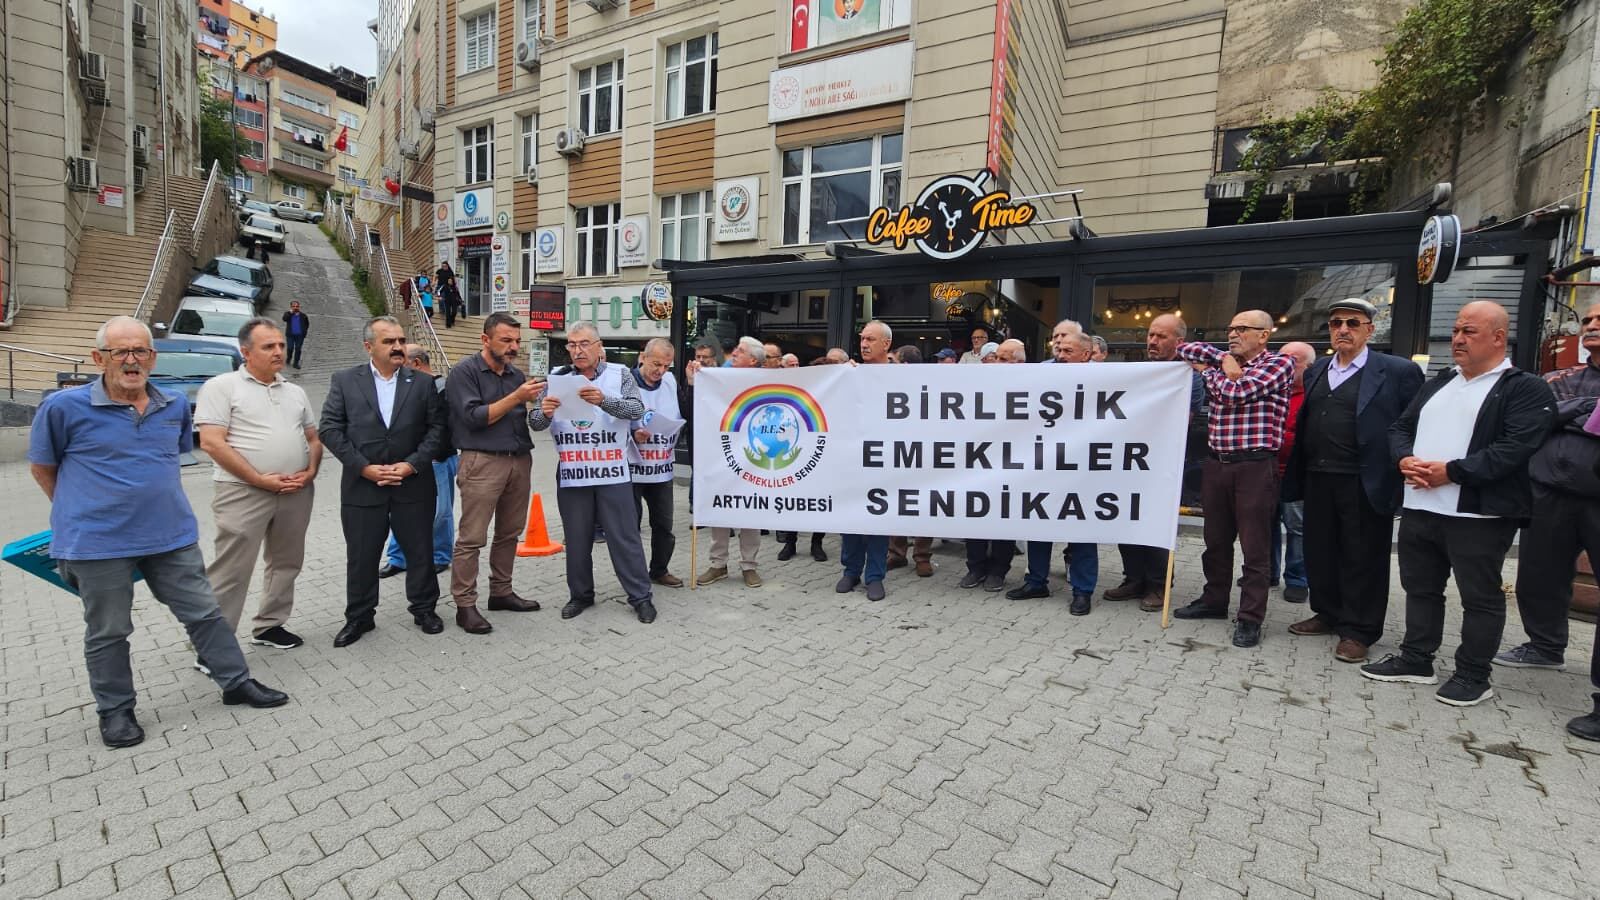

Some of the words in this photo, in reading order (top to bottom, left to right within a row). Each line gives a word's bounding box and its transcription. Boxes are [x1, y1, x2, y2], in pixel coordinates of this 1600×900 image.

[867, 207, 932, 248] Cafee
[972, 192, 1034, 231] Time
[886, 383, 1128, 428] BİRLEŞİK
[721, 434, 743, 476] BİRLEŞİK
[742, 471, 795, 488] EMEKLİLER
[794, 435, 827, 481] SENDİKASI
[862, 435, 1151, 471] EMEKLİLER
[561, 466, 624, 480] ENDİKASI
[712, 492, 769, 510] ARTVİN
[774, 495, 833, 514] ŞUBESİ
[866, 484, 1141, 521] SENDİKASI
